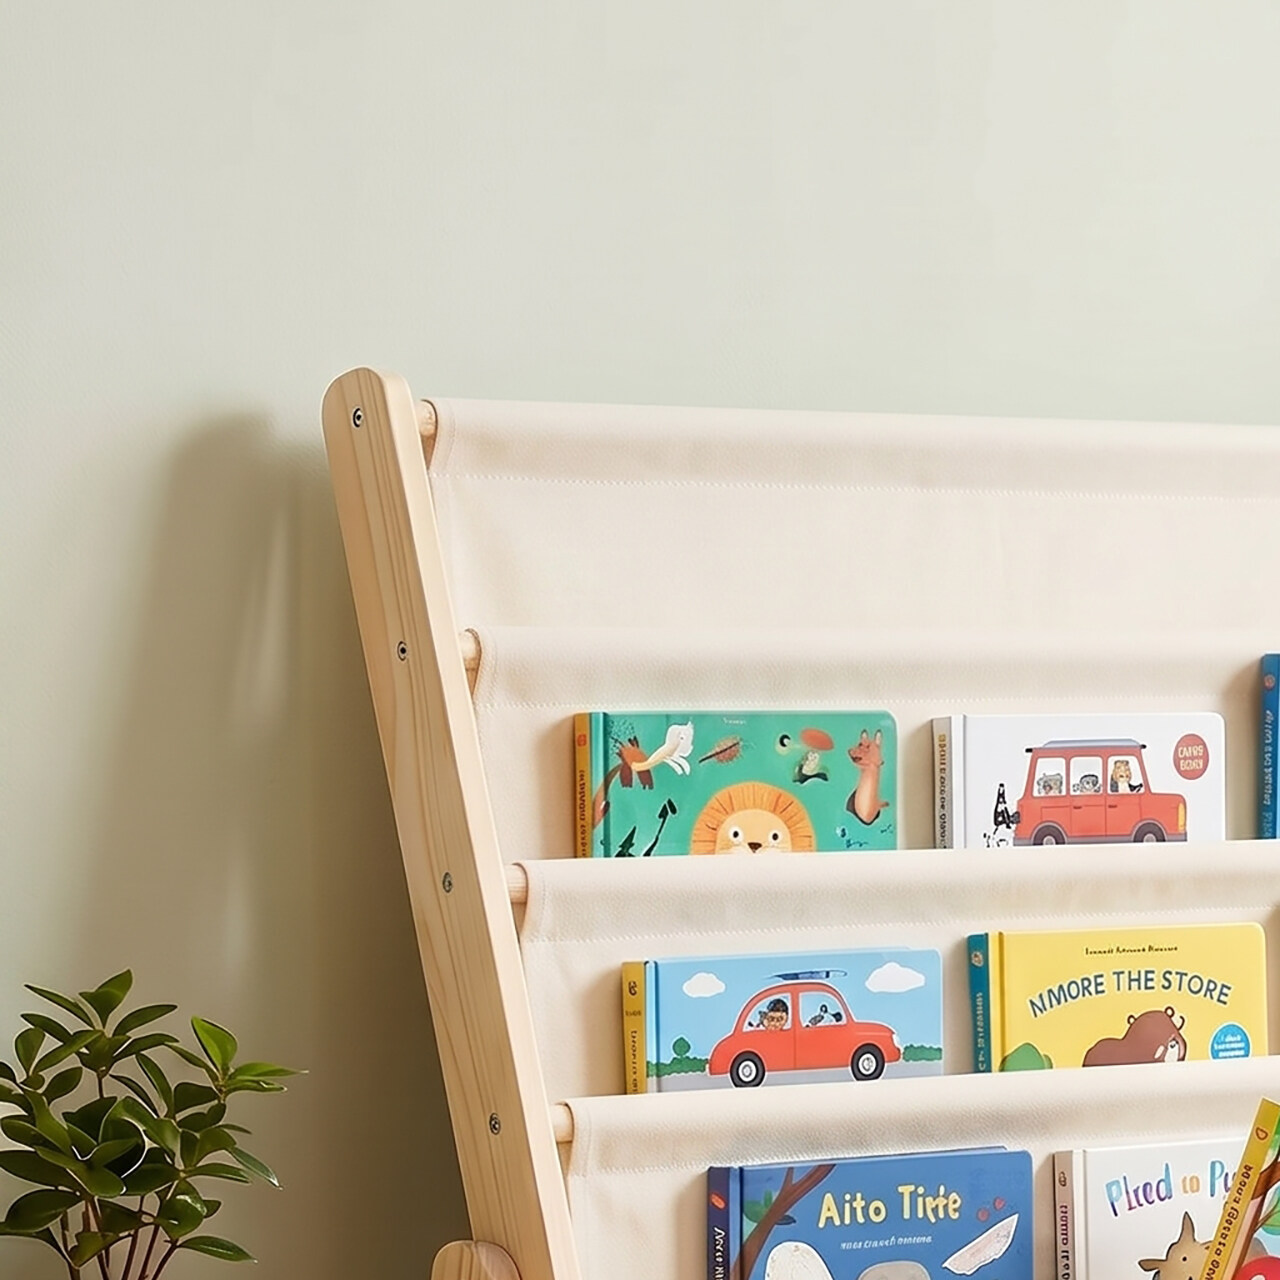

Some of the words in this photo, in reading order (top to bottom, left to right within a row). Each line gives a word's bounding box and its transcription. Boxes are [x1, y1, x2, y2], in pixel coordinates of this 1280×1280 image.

[1112, 970, 1156, 991] THE
[1161, 970, 1232, 1005] STORE
[818, 1192, 887, 1228] Aito
